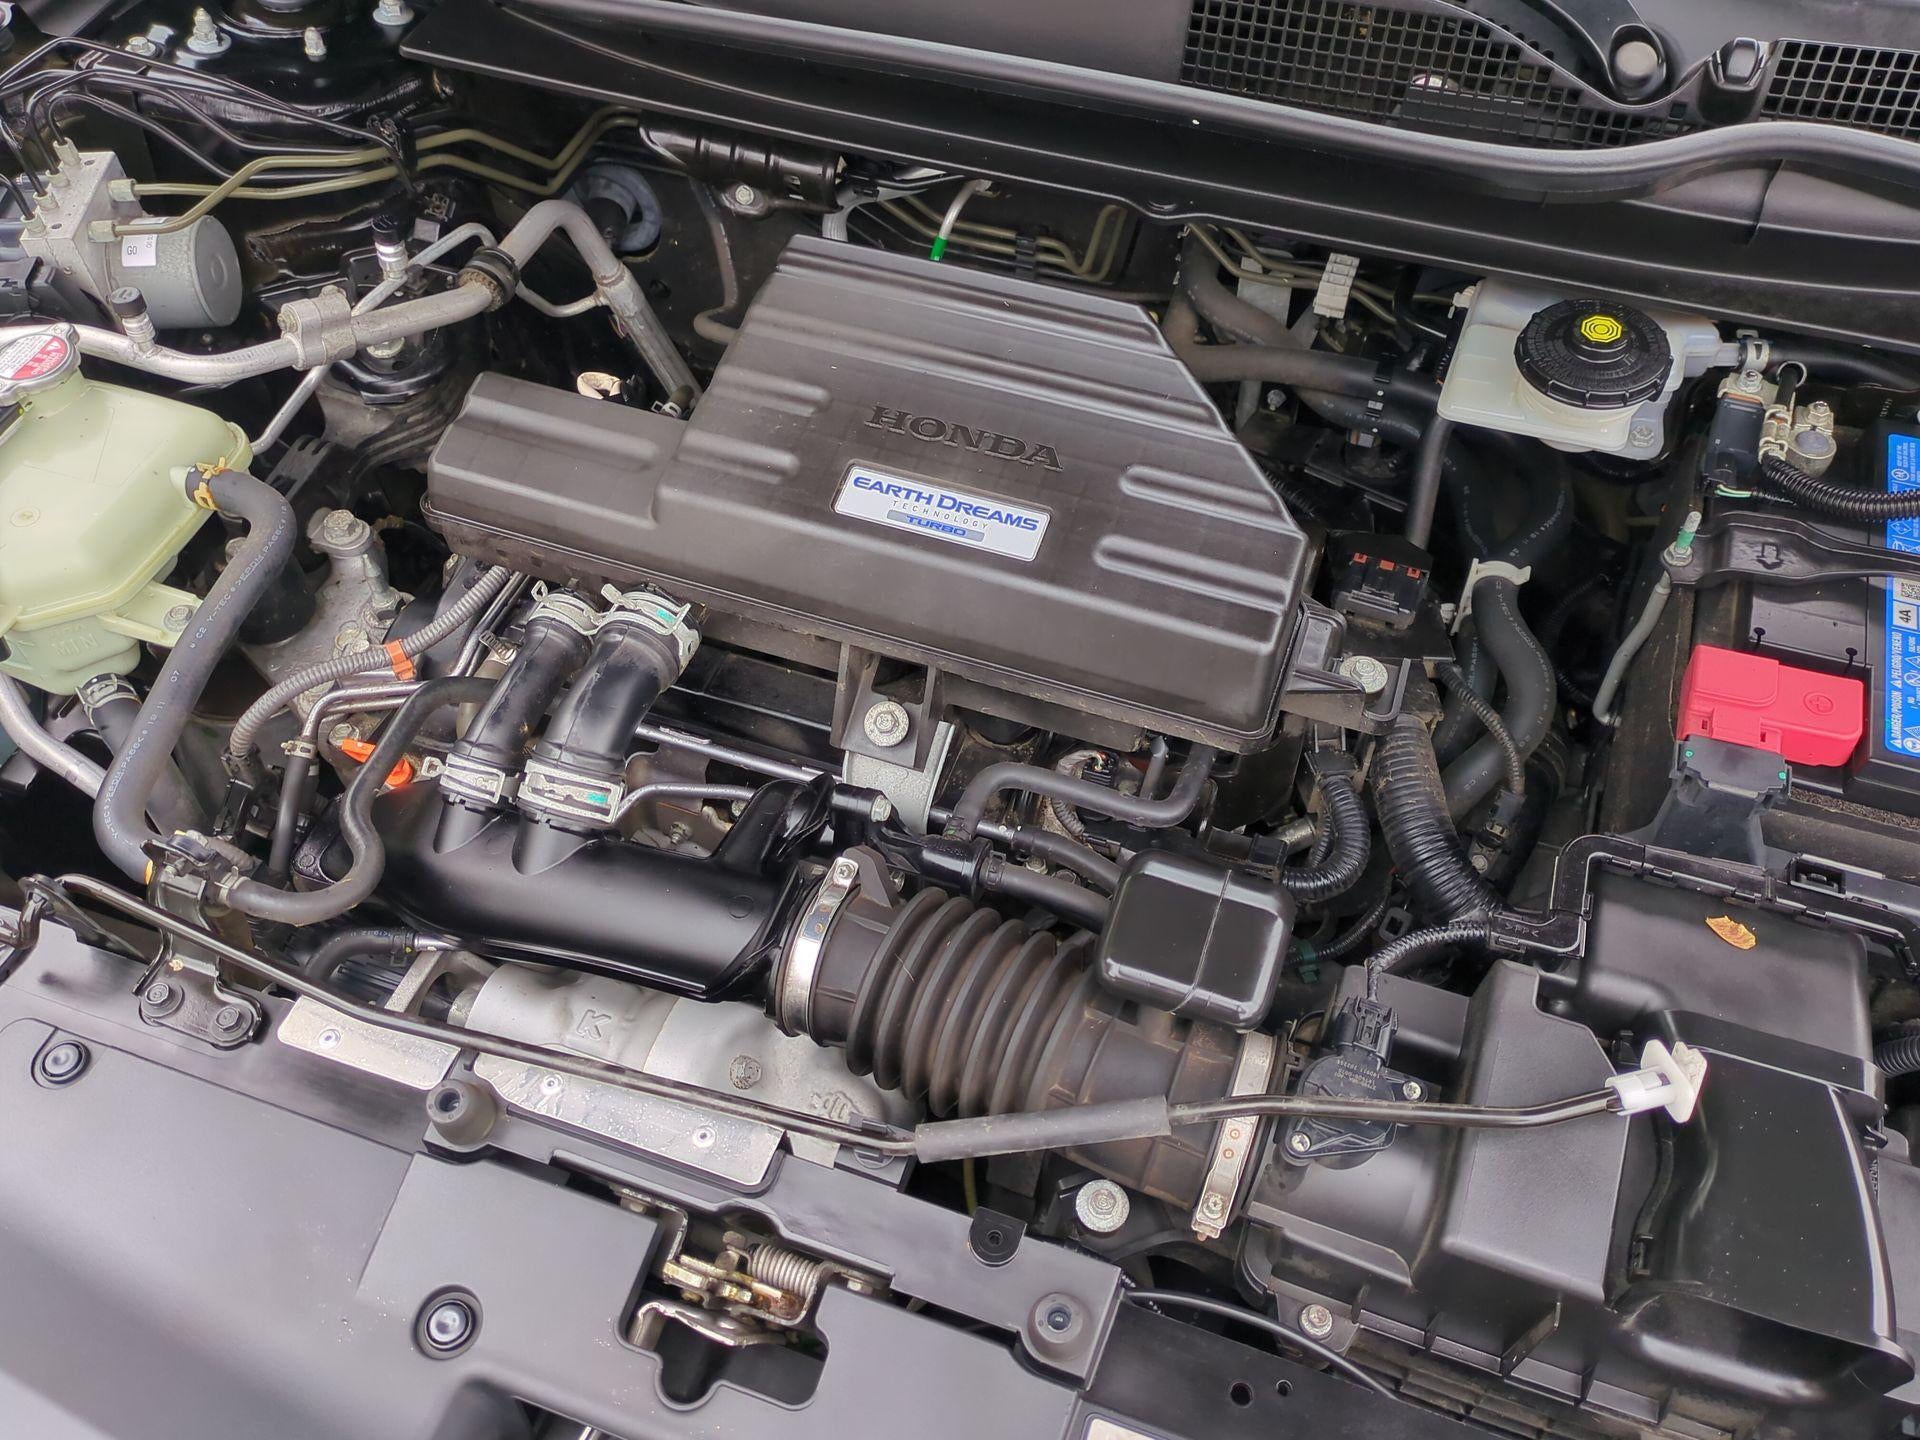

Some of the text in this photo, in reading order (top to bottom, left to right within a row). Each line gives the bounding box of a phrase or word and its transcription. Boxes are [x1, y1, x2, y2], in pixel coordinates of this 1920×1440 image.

[864, 405, 1064, 473] HONDA
[853, 475, 935, 504] EARTH
[892, 500, 989, 530] TECHNOLOGY
[906, 515, 967, 537] TURBO
[195, 627, 208, 639] C2
[206, 593, 232, 622] Y-TEC
[1898, 609, 1912, 623] 4A
[57, 632, 98, 657] MIN
[1891, 690, 1903, 739] DANGER/POISON
[576, 1008, 612, 1041] K
